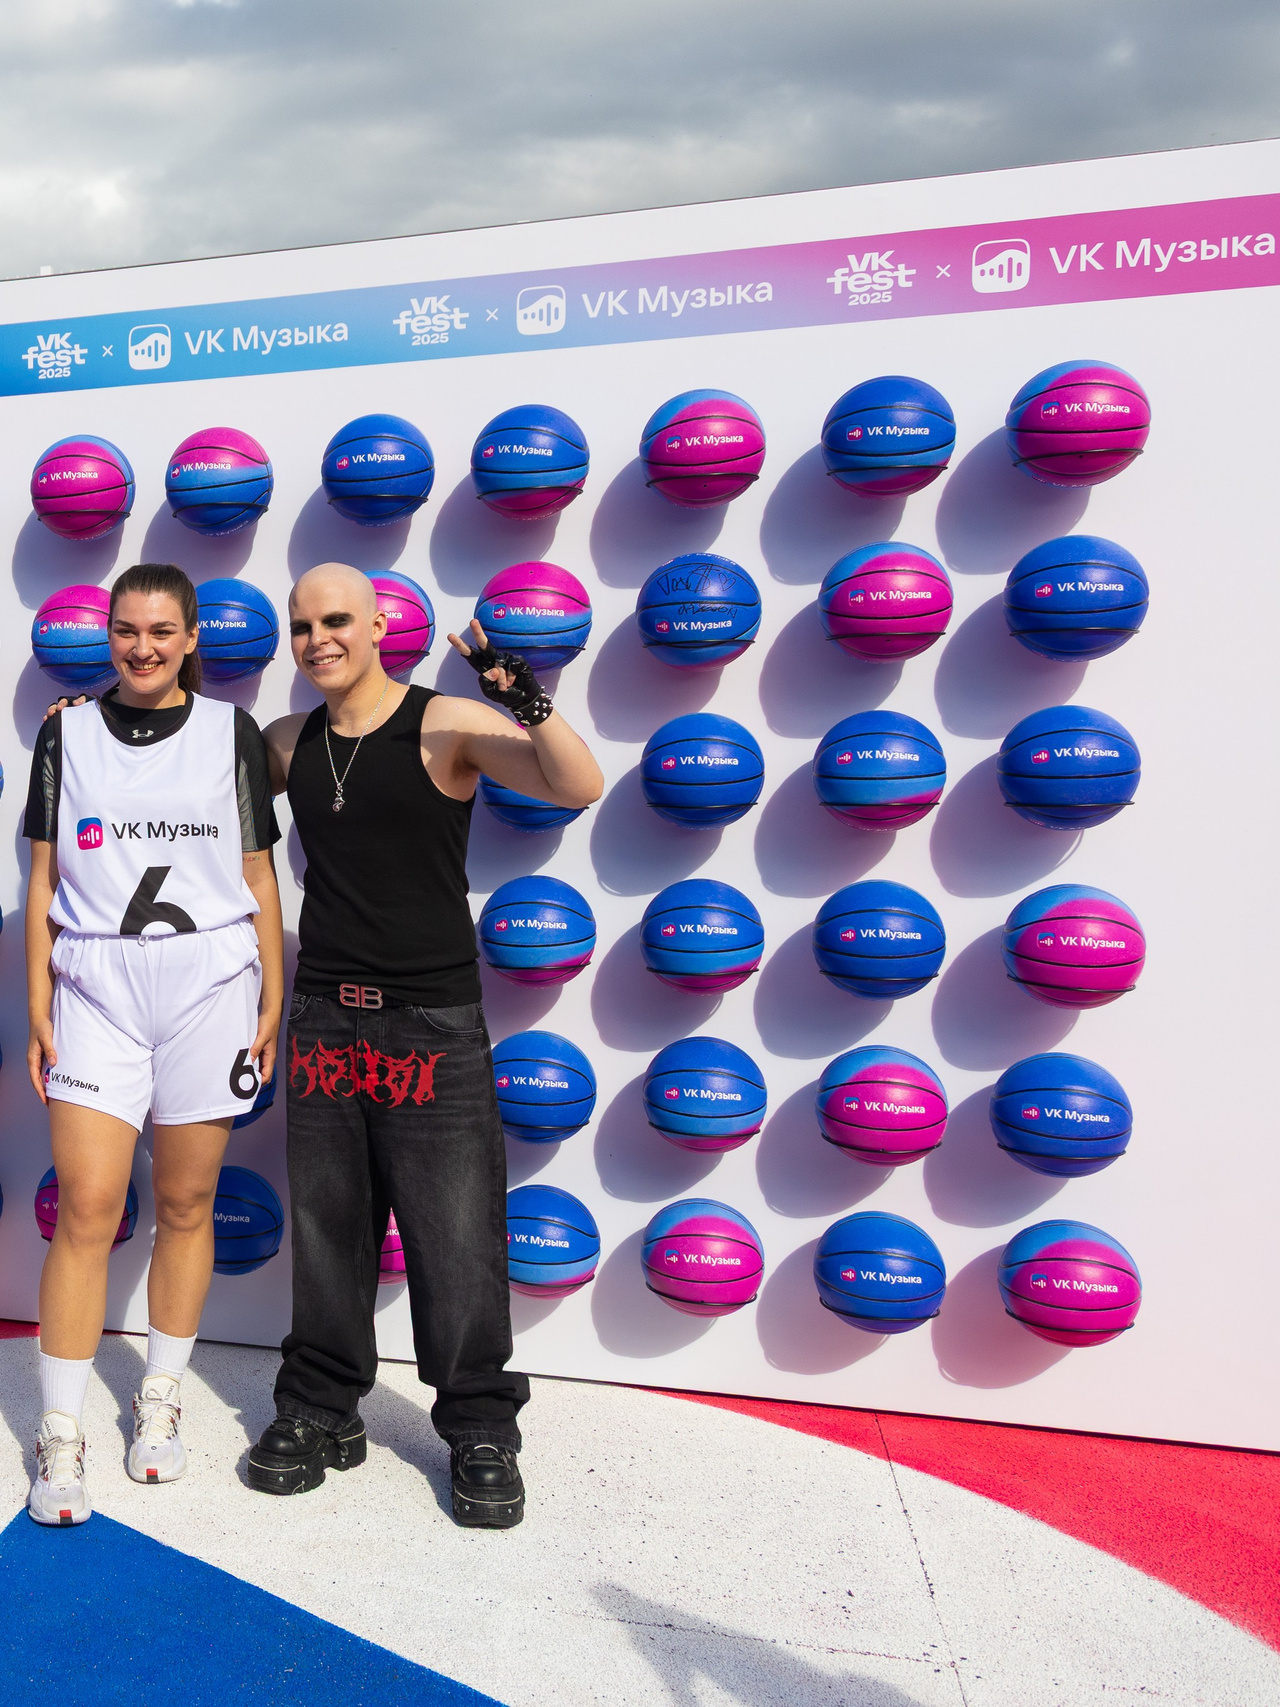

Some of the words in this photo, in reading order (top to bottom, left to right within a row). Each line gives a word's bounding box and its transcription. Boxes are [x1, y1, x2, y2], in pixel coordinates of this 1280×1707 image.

[1049, 242, 1105, 274] VK
[1116, 233, 1276, 273] Музыка
[847, 250, 896, 273] VK
[826, 263, 917, 295] fest
[582, 289, 629, 318] VK
[638, 281, 773, 317] Музыка
[848, 290, 893, 306] 2025
[410, 295, 451, 315] VK
[393, 307, 469, 335] fest
[37, 332, 72, 350] VK
[184, 329, 225, 355] VK
[232, 322, 349, 354] Музыка
[411, 332, 449, 346] 2025
[22, 343, 88, 369] fest
[38, 367, 71, 379] 2025
[1065, 403, 1082, 412] VK
[1086, 403, 1130, 414] Музыка
[867, 426, 883, 436] VK
[886, 426, 929, 437] Музыка
[686, 436, 701, 446] VK
[704, 435, 743, 446] Музыка
[498, 445, 511, 453] VK
[513, 445, 552, 456] Музыка
[352, 454, 365, 463] VK
[368, 453, 405, 463] Музыка
[183, 462, 193, 471] VK
[195, 461, 231, 471] Музыка
[50, 472, 61, 480] VK
[63, 471, 98, 480] Музыка
[1058, 582, 1075, 591] VK
[1078, 582, 1124, 592] Музыка
[870, 591, 886, 600] VK
[890, 590, 931, 601] Музыка
[384, 611, 403, 619] ыка
[510, 607, 524, 615] VK
[526, 607, 564, 617] Музыка
[51, 622, 62, 630] VK
[64, 621, 98, 630] Музыка
[210, 620, 246, 629] Музыка
[673, 622, 688, 630] VK
[691, 620, 732, 631] Музыка
[857, 750, 873, 759] VK
[876, 750, 919, 761] Музыка
[1054, 748, 1072, 757] VK
[1075, 748, 1119, 758] Музыка
[680, 756, 695, 764] VK
[698, 756, 738, 766] Музыка
[111, 823, 142, 840] VK
[147, 821, 219, 841] Музыка
[512, 919, 525, 927] VK
[528, 920, 567, 930] Музыка
[697, 925, 738, 935] Музыка
[860, 929, 876, 937] VK
[879, 929, 921, 940] Музыка
[1060, 936, 1078, 945] VK
[1081, 937, 1125, 949] Музыка
[229, 1048, 259, 1100] 6
[51, 1072, 61, 1083] VK
[61, 1075, 100, 1092] Музыка
[513, 1076, 526, 1085] VK
[529, 1078, 568, 1088] Музыка
[684, 1088, 698, 1097] VK
[701, 1090, 741, 1101] Музыка
[864, 1102, 880, 1111] VK
[884, 1103, 925, 1114] Музыка
[1044, 1108, 1062, 1118] VK
[1065, 1110, 1110, 1122] Музыка
[214, 1213, 250, 1223] Музыка
[515, 1234, 528, 1243] VK
[530, 1236, 569, 1248] Музыка
[683, 1254, 698, 1263] VK
[701, 1255, 740, 1266] Музыка
[860, 1271, 876, 1280] VK
[880, 1273, 922, 1284] Музыка
[1052, 1279, 1070, 1289] VK
[1073, 1280, 1118, 1292] Музыка
